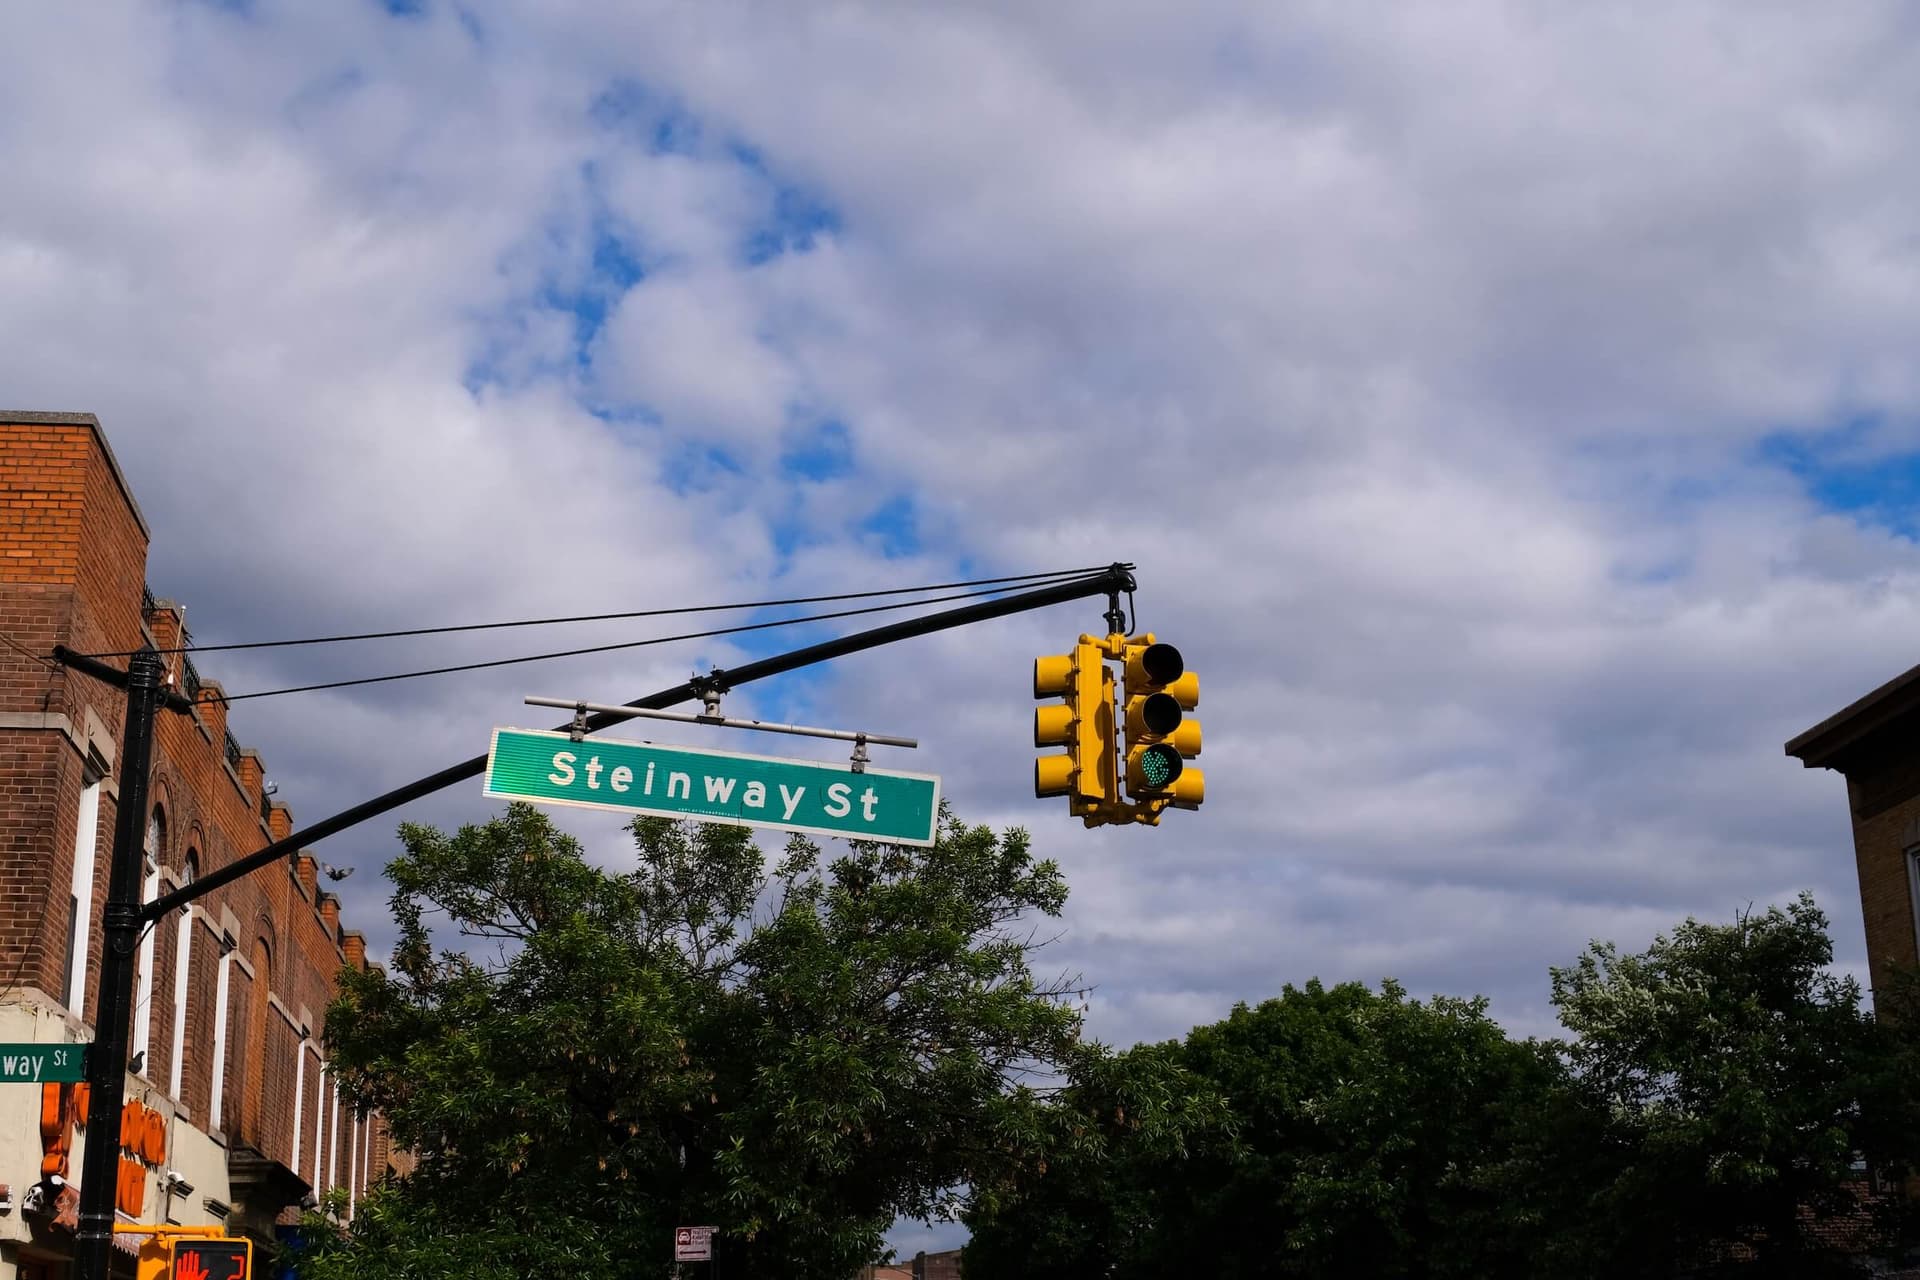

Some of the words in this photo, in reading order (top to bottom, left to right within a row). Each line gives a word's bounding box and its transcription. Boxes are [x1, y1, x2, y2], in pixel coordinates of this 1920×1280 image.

[549, 751, 805, 820] Steinway
[823, 783, 879, 822] St
[3, 1055, 44, 1082] way
[53, 1049, 68, 1067] St
